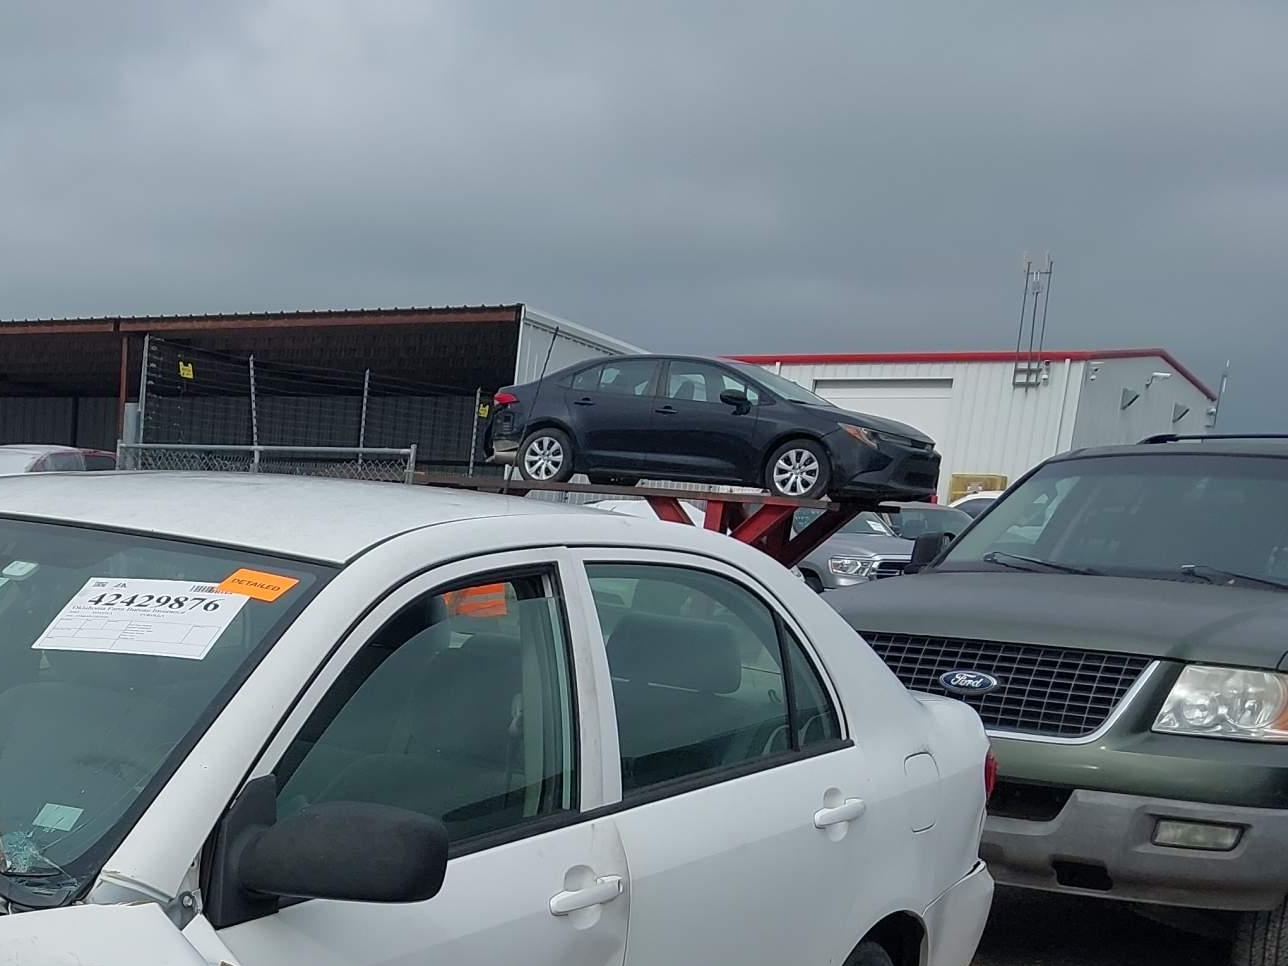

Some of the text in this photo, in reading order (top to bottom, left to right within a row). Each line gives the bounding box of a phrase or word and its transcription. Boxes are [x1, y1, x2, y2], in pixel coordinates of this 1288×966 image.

[232, 578, 281, 592] DETAILED
[87, 592, 225, 612] 42429876
[950, 672, 984, 688] Ford
